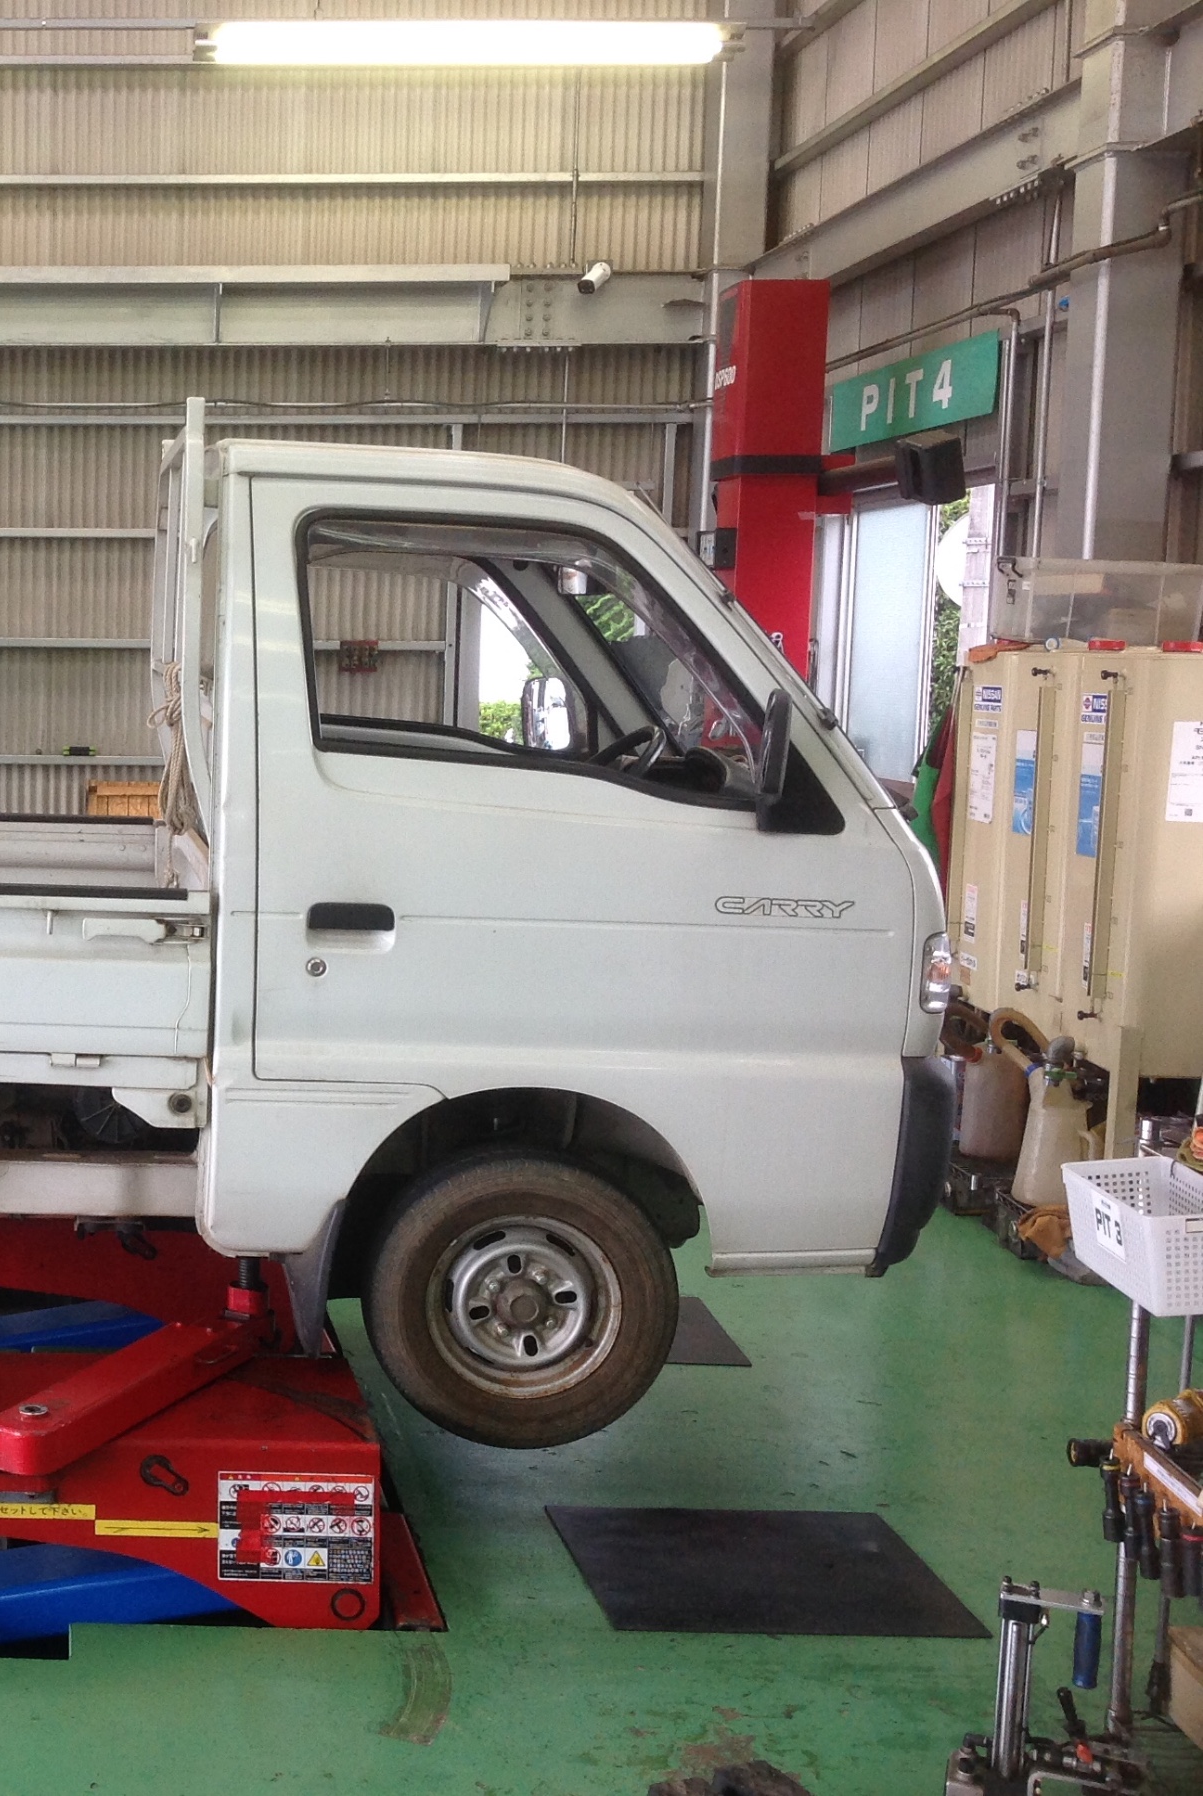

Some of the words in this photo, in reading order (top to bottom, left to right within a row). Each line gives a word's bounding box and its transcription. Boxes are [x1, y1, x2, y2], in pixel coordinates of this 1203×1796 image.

[860, 368, 924, 432] PIT
[932, 359, 953, 410] 4
[715, 896, 855, 919] CARRY
[1095, 1207, 1111, 1239] PIT
[1114, 1220, 1123, 1247] 3
